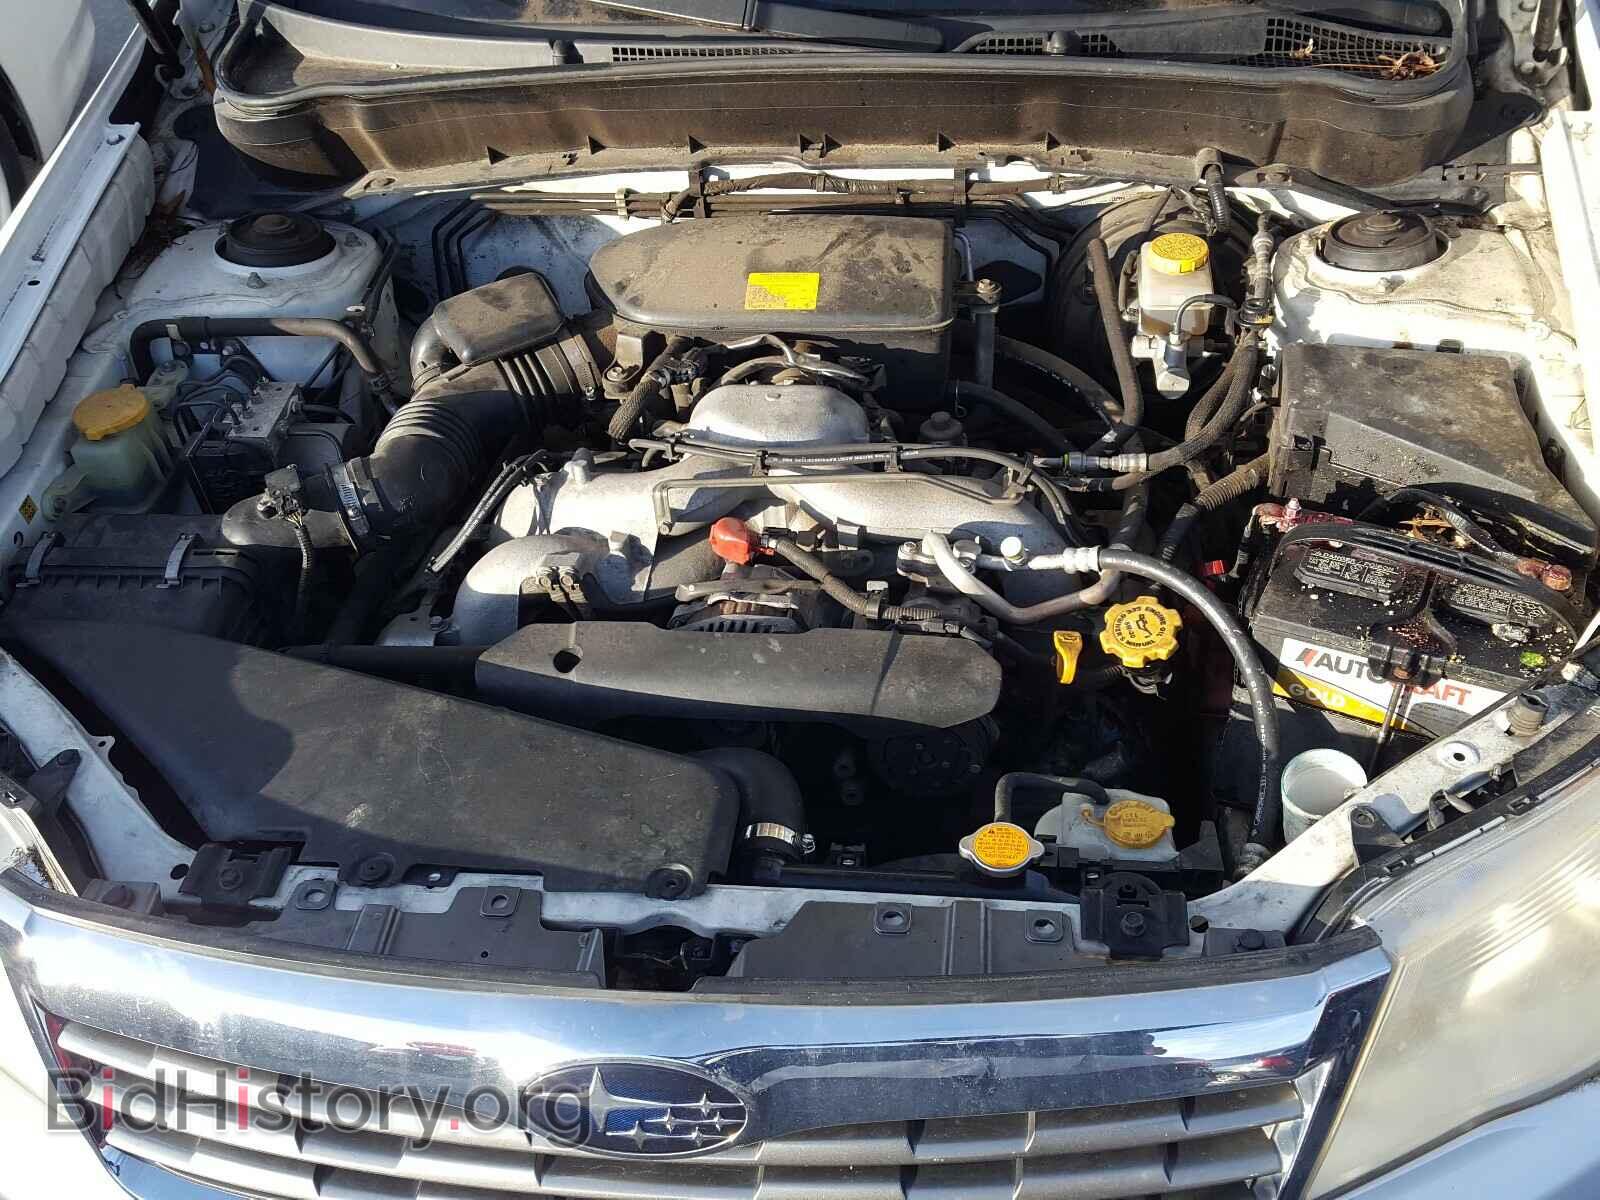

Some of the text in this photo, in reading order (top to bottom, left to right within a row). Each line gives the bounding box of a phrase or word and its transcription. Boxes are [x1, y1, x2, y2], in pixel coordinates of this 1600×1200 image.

[1145, 606, 1167, 637] ENGINE OIL
[1289, 682, 1346, 707] GOLD
